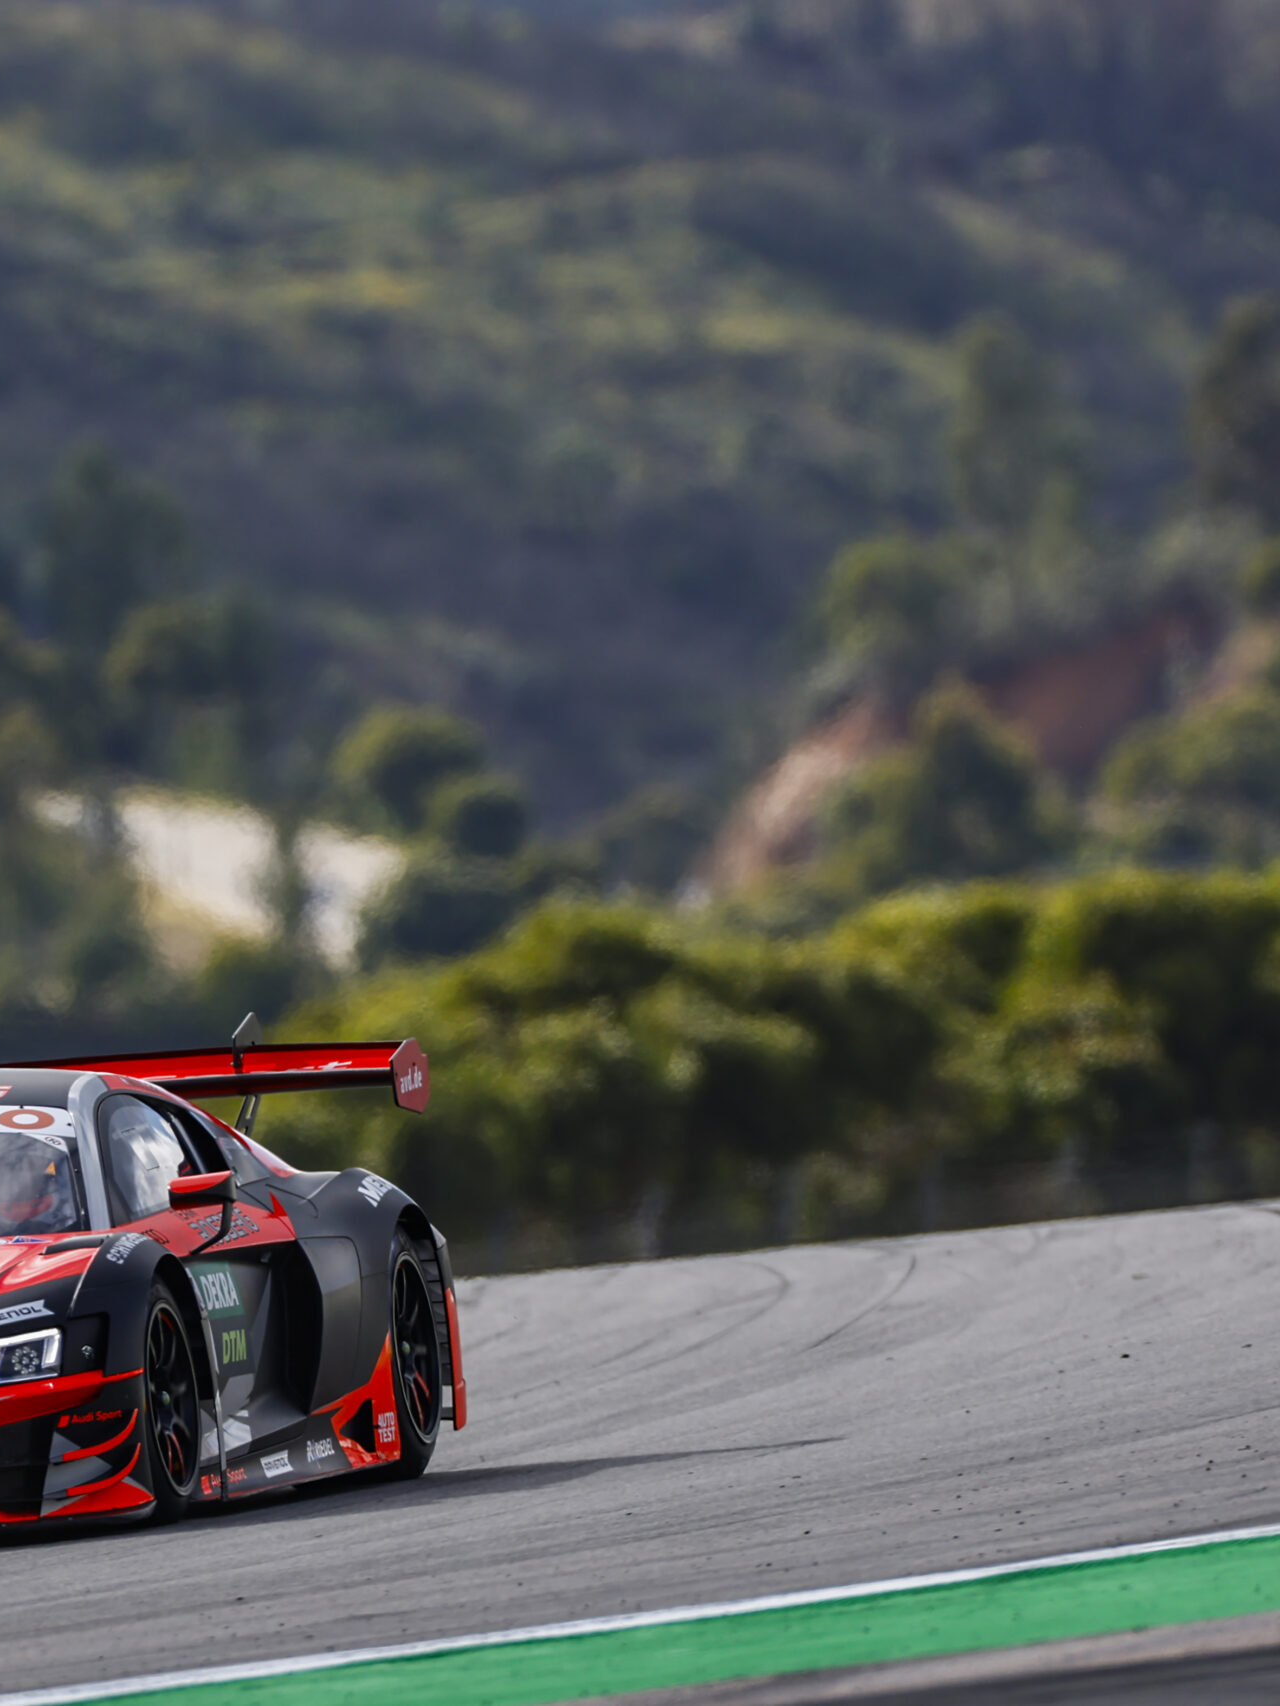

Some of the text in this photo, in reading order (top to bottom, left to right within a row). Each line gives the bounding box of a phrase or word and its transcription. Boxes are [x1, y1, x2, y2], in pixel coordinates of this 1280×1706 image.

[400, 1066, 423, 1094] avd.de
[200, 1271, 240, 1311] DEKRA
[222, 1328, 247, 1364] DTM
[71, 1409, 123, 1424] Audi Sport
[378, 1411, 395, 1427] AUTO
[378, 1426, 396, 1443] TEST
